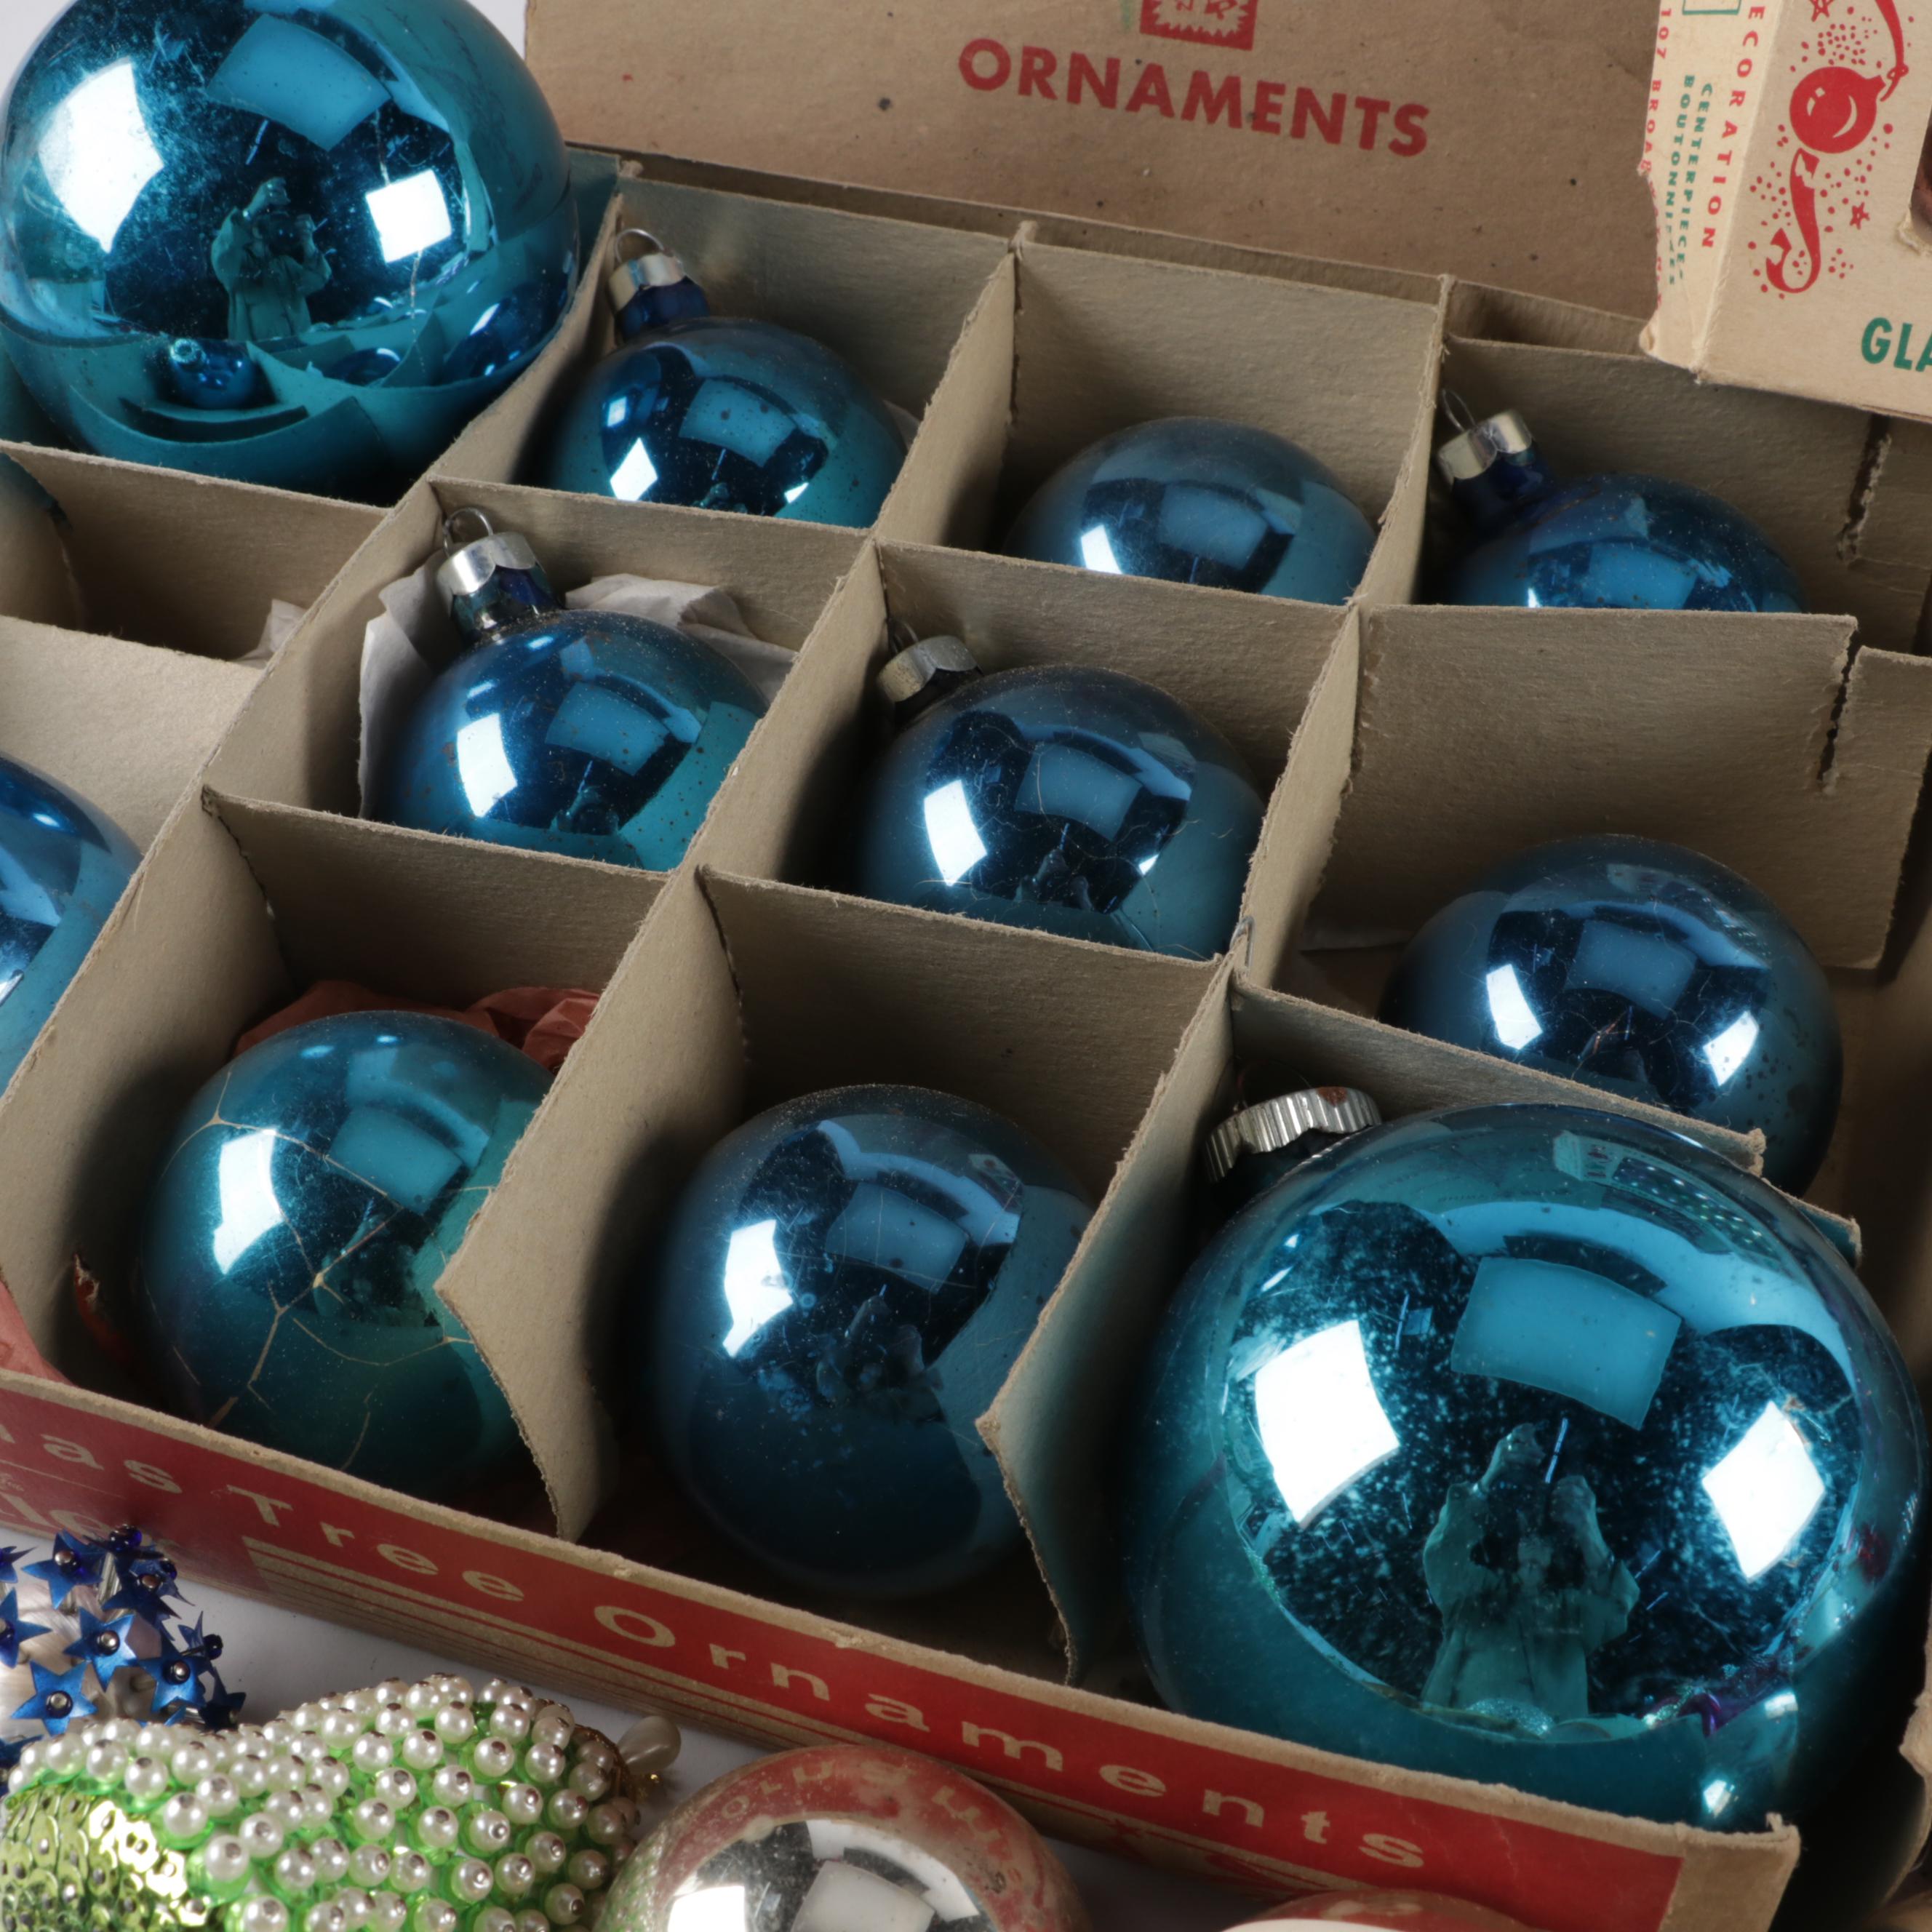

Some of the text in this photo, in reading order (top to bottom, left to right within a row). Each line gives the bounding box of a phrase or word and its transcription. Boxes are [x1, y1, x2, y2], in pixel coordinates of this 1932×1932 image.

[959, 39, 1429, 156] ORNAMENTS
[0, 1423, 182, 1493] as
[228, 1485, 524, 1601] Tree
[594, 1605, 1424, 1868] Ornaments
